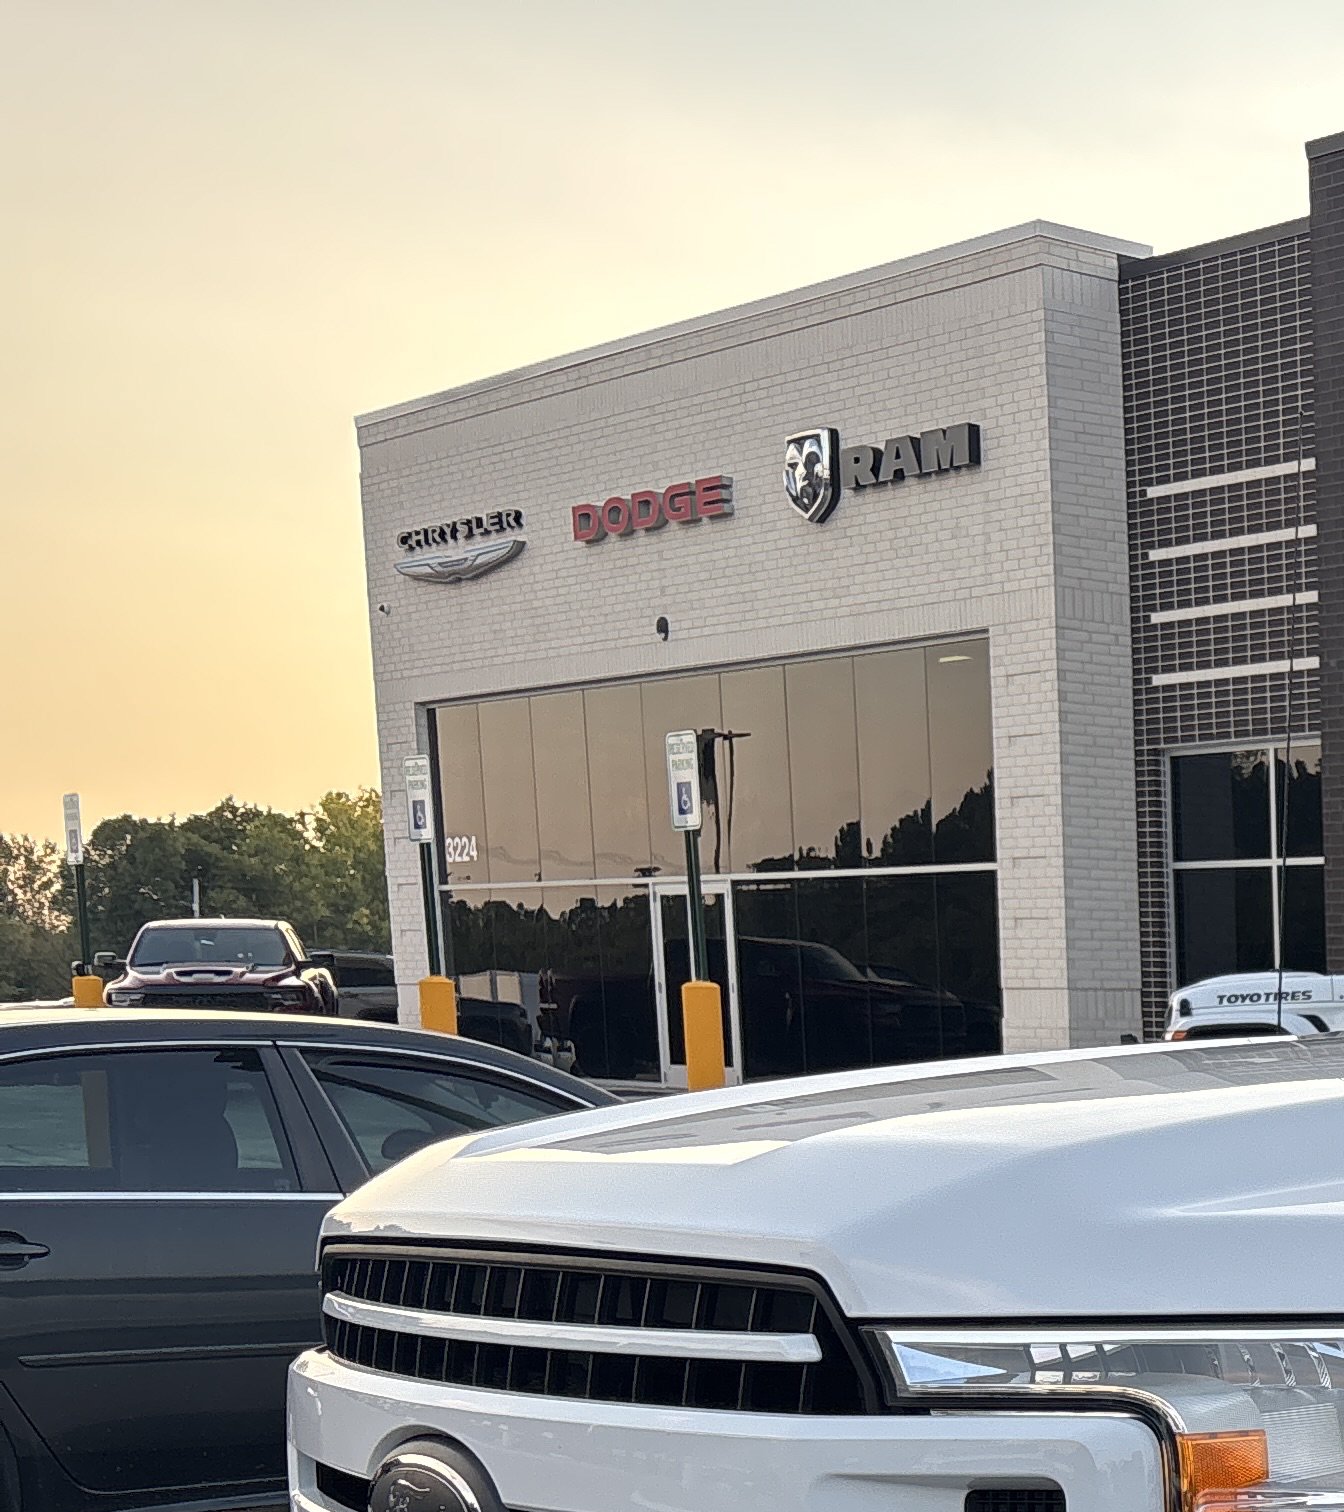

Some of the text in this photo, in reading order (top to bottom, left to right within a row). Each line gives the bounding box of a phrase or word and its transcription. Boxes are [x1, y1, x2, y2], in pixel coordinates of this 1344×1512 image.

[840, 422, 981, 492] RAM
[396, 509, 524, 551] CHRYSLER
[571, 475, 734, 543] DODGE
[446, 835, 478, 863] 3224
